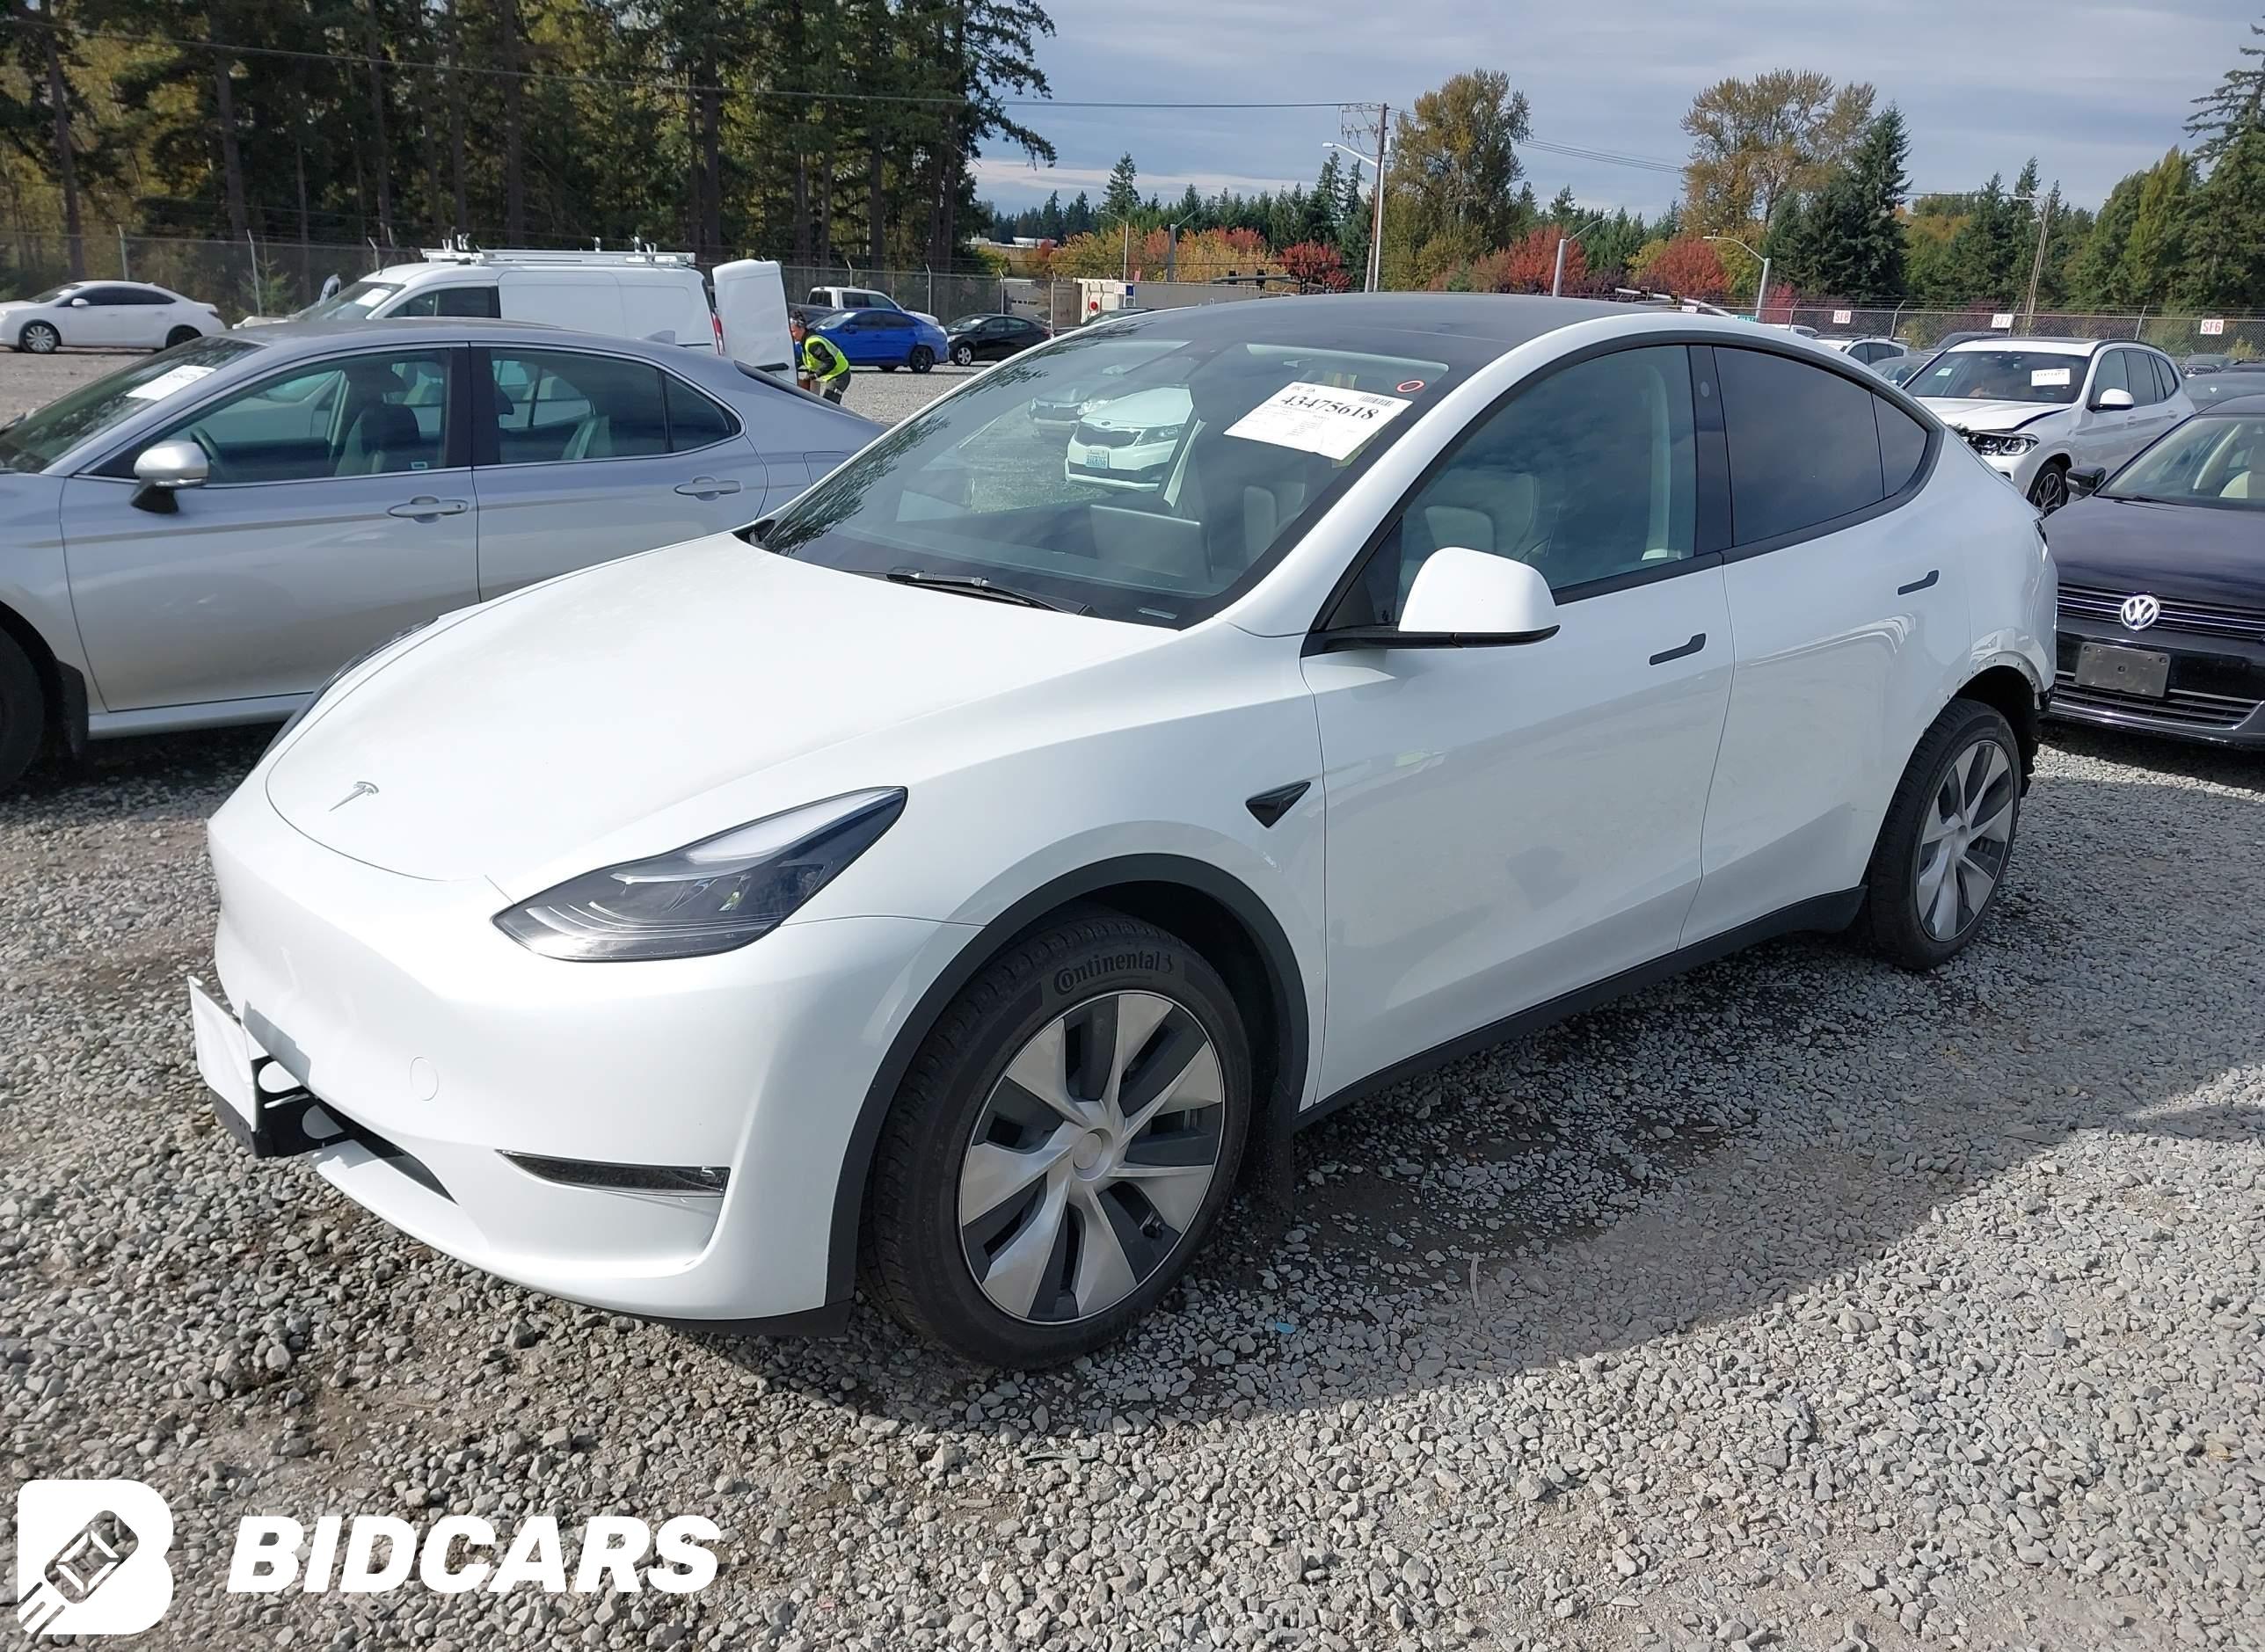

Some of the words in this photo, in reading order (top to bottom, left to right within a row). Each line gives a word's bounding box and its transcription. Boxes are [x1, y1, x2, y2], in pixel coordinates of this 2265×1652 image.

[1835, 311, 1849, 322] SF8
[1994, 316, 2010, 326] SF7
[2203, 321, 2222, 332] SF6
[1280, 394, 1379, 420] 43475618
[1053, 950, 1161, 995] Continental
